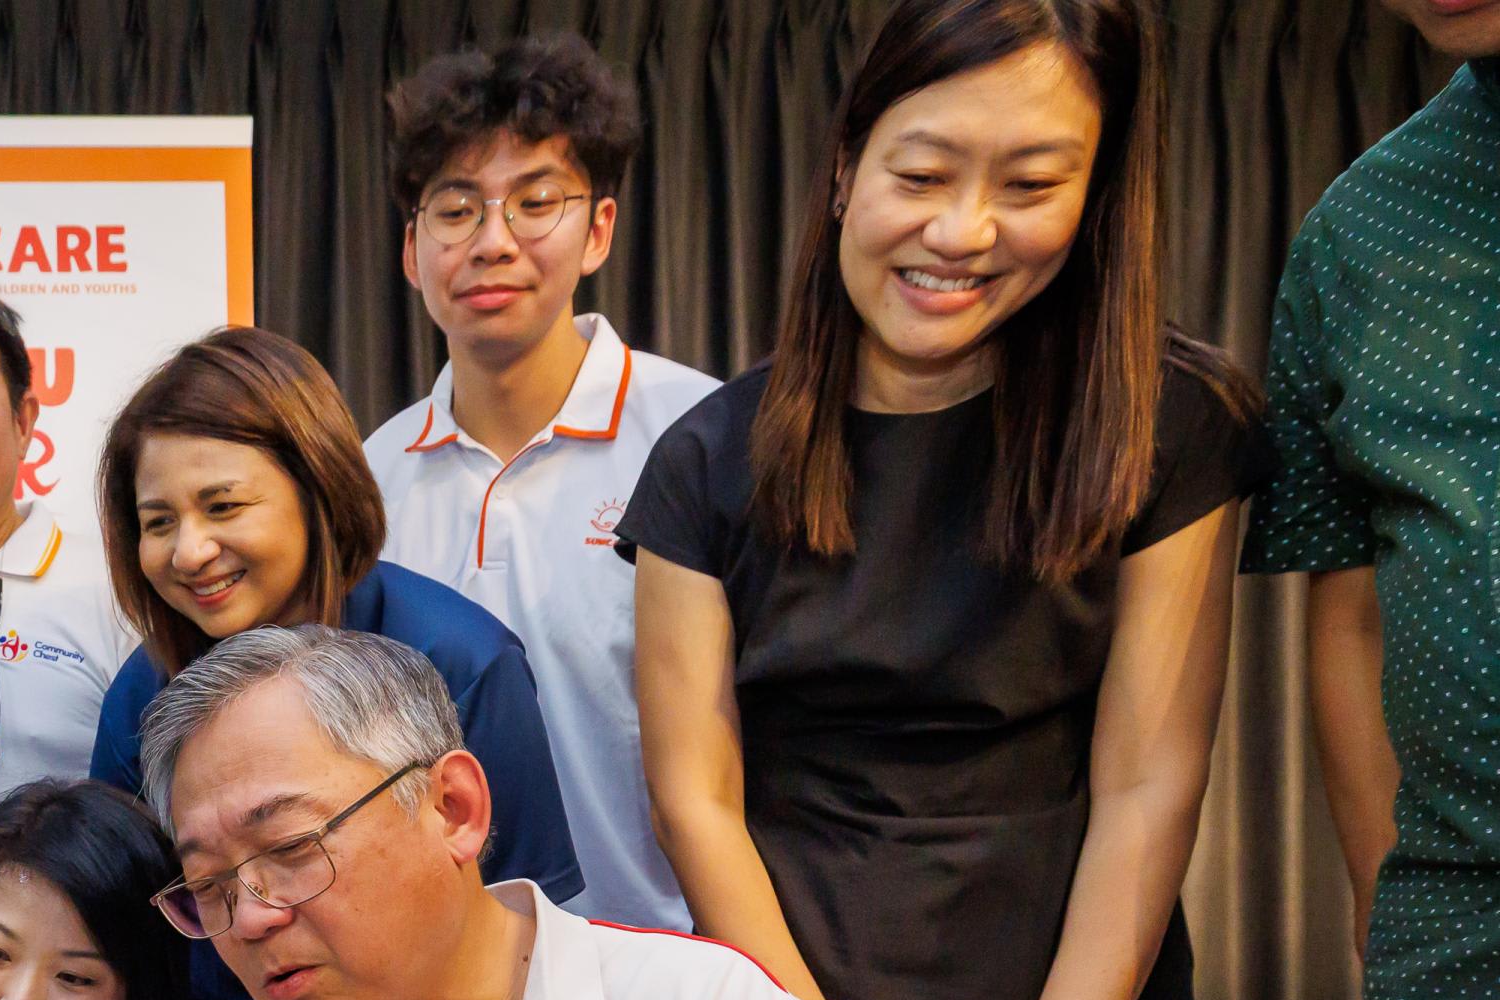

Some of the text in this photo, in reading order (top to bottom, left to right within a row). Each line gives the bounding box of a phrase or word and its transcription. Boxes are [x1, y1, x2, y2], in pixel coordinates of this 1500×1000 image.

[52, 283, 80, 294] AND
[86, 283, 137, 295] YOUTHS
[33, 650, 58, 661] Chest
[35, 641, 84, 663] Community
